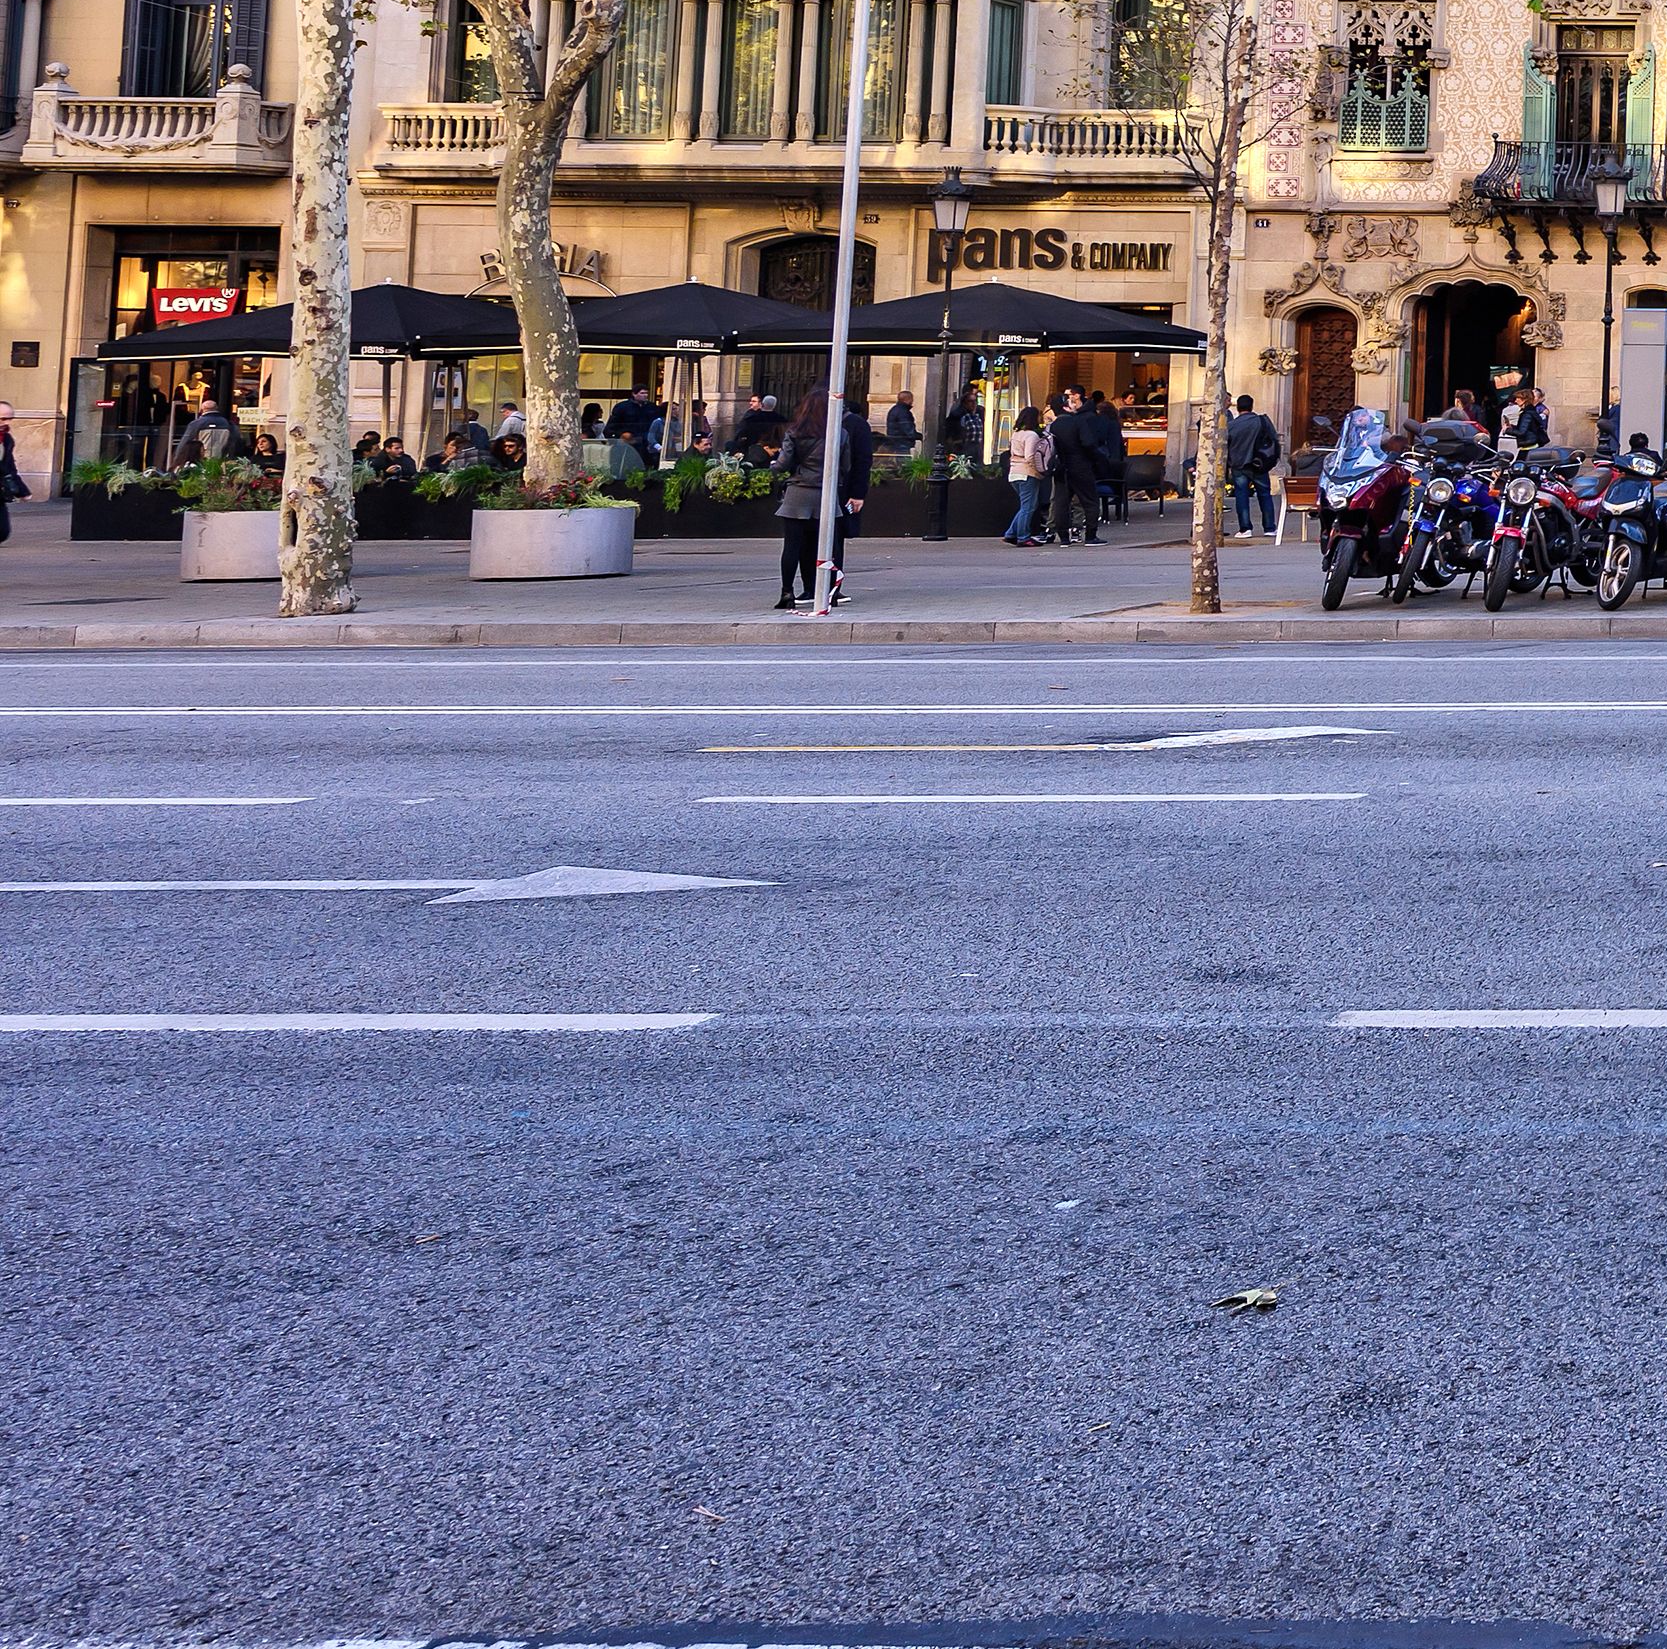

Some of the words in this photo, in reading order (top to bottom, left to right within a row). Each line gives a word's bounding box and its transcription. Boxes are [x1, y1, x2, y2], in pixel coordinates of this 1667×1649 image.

[927, 227, 1068, 284] pans
[1071, 242, 1086, 271] &
[1089, 242, 1174, 271] COMPANY
[677, 339, 700, 349] pans
[999, 334, 1022, 345] pans
[361, 345, 385, 356] pans
